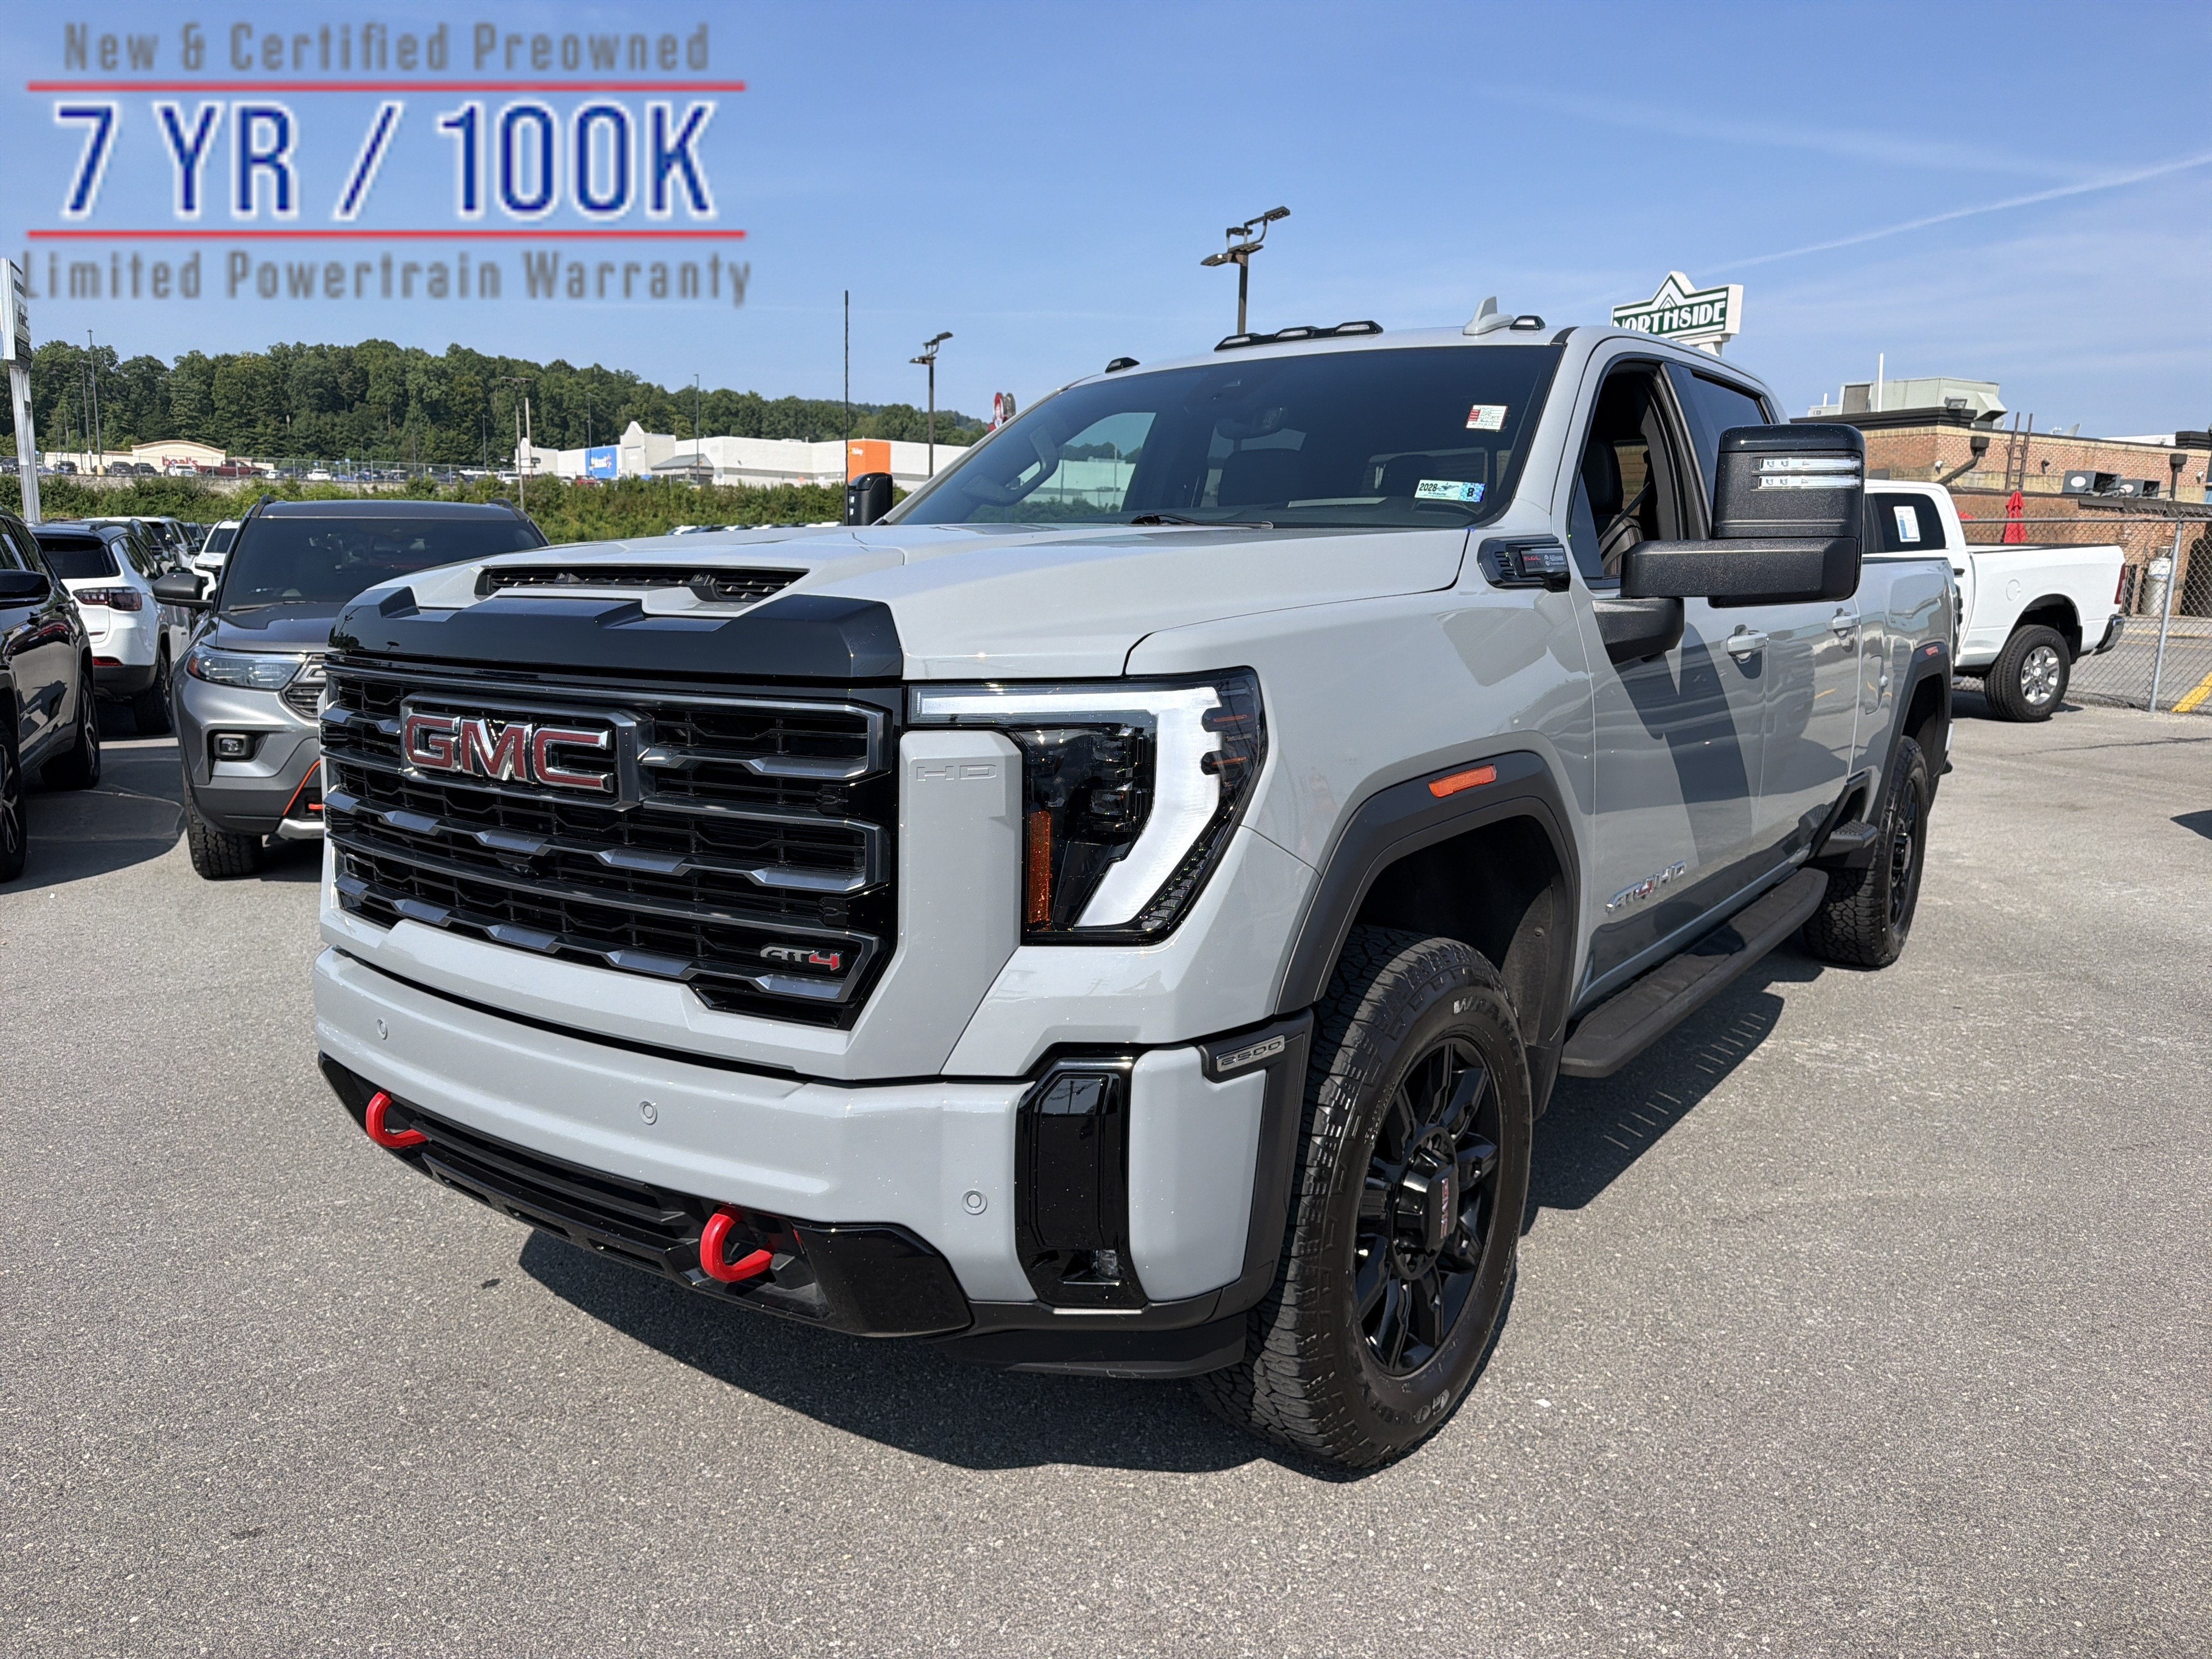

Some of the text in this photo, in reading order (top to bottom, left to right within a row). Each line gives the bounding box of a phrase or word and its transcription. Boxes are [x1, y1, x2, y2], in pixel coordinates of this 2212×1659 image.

[1418, 482, 1438, 492] 2028
[1466, 487, 1475, 497] 8
[405, 713, 614, 793] GMC
[916, 764, 997, 782] HD
[760, 946, 841, 971] AT4
[1221, 1041, 1282, 1067] 2500
